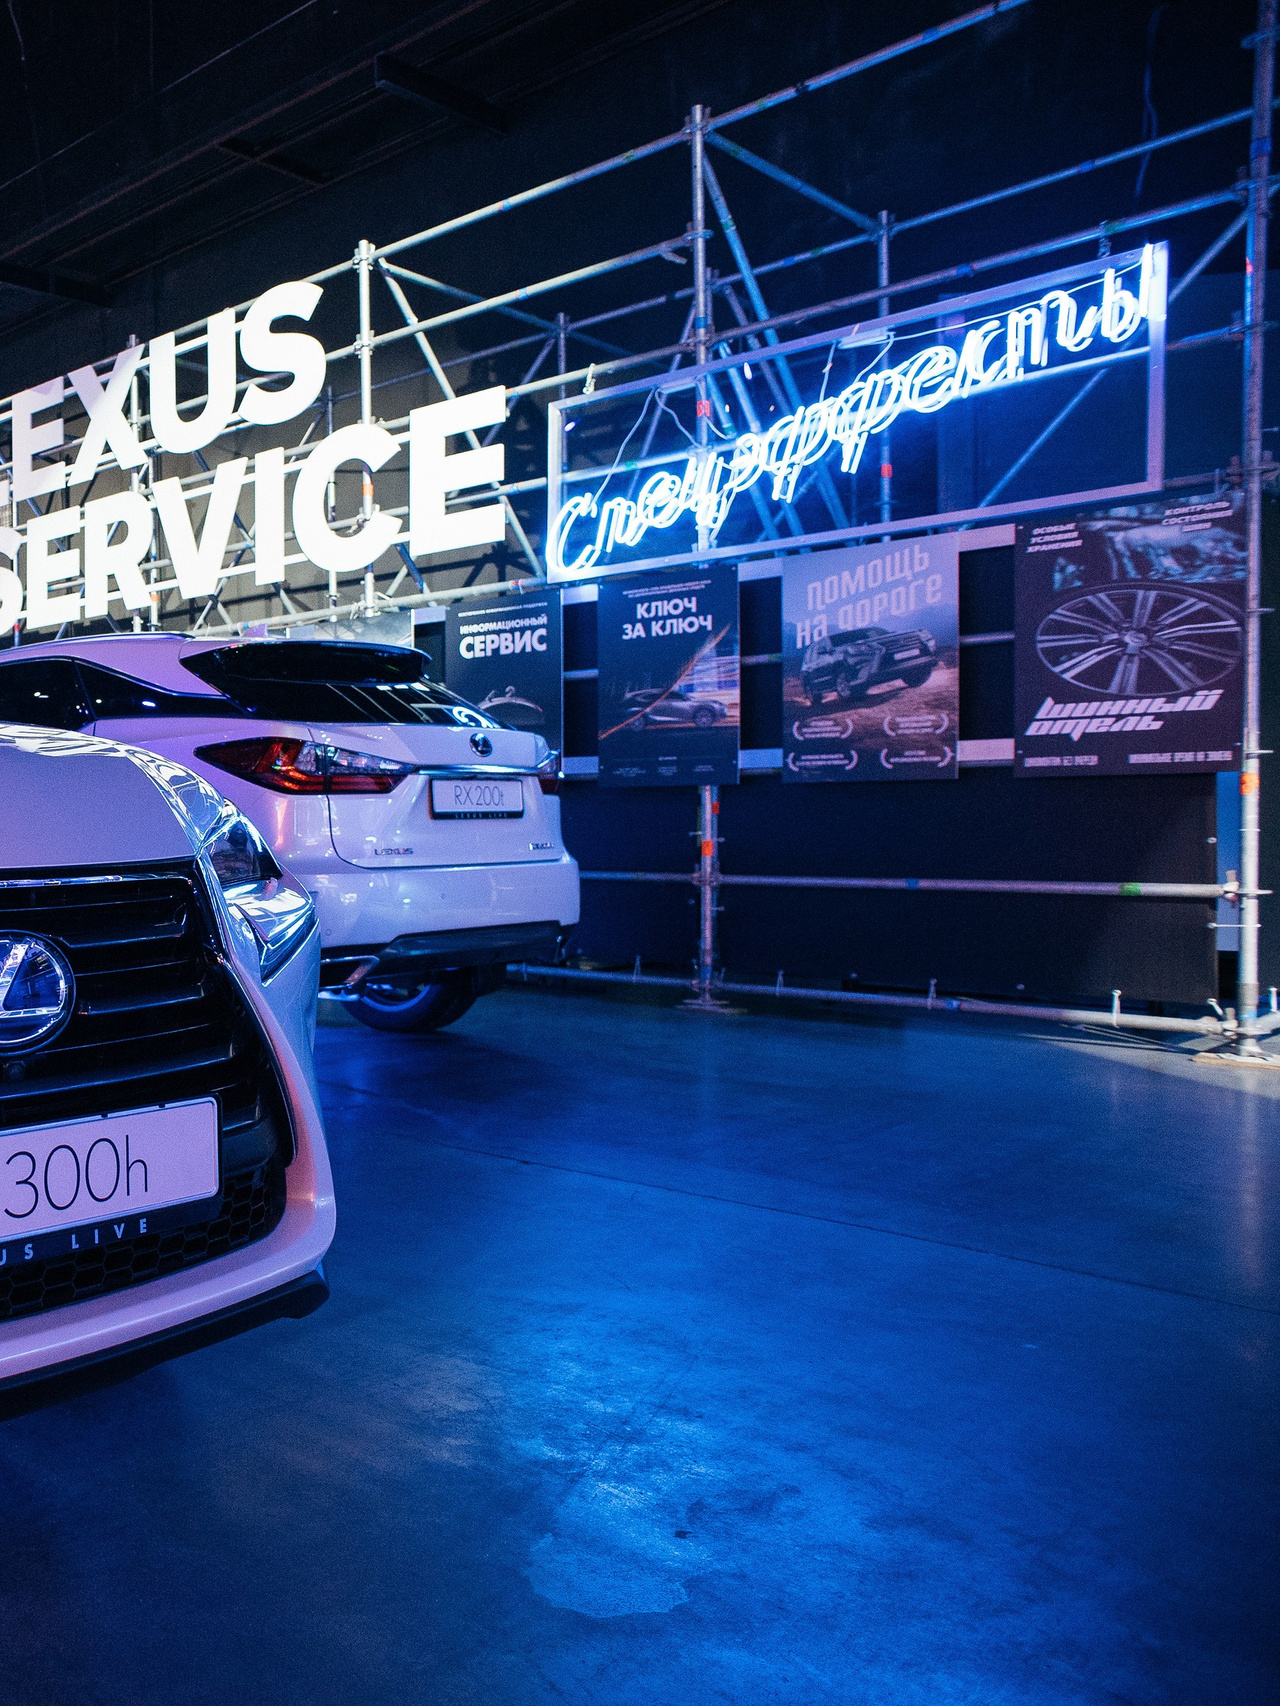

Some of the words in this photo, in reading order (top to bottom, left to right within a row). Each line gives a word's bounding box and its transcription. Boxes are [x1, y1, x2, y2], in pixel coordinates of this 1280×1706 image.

[546, 242, 1153, 573] Спецэффекты
[636, 596, 697, 619] КЛЮЧ
[459, 613, 548, 635] ИНФОРМАЦИОННЫЙ
[621, 622, 646, 640] ЗА
[651, 614, 713, 637] КЛЮЧ
[459, 628, 548, 660] СЕРВИС
[453, 784, 473, 806] RX
[475, 785, 505, 807] 200t
[3, 1134, 148, 1219] 300h
[71, 1217, 147, 1250] LIVE
